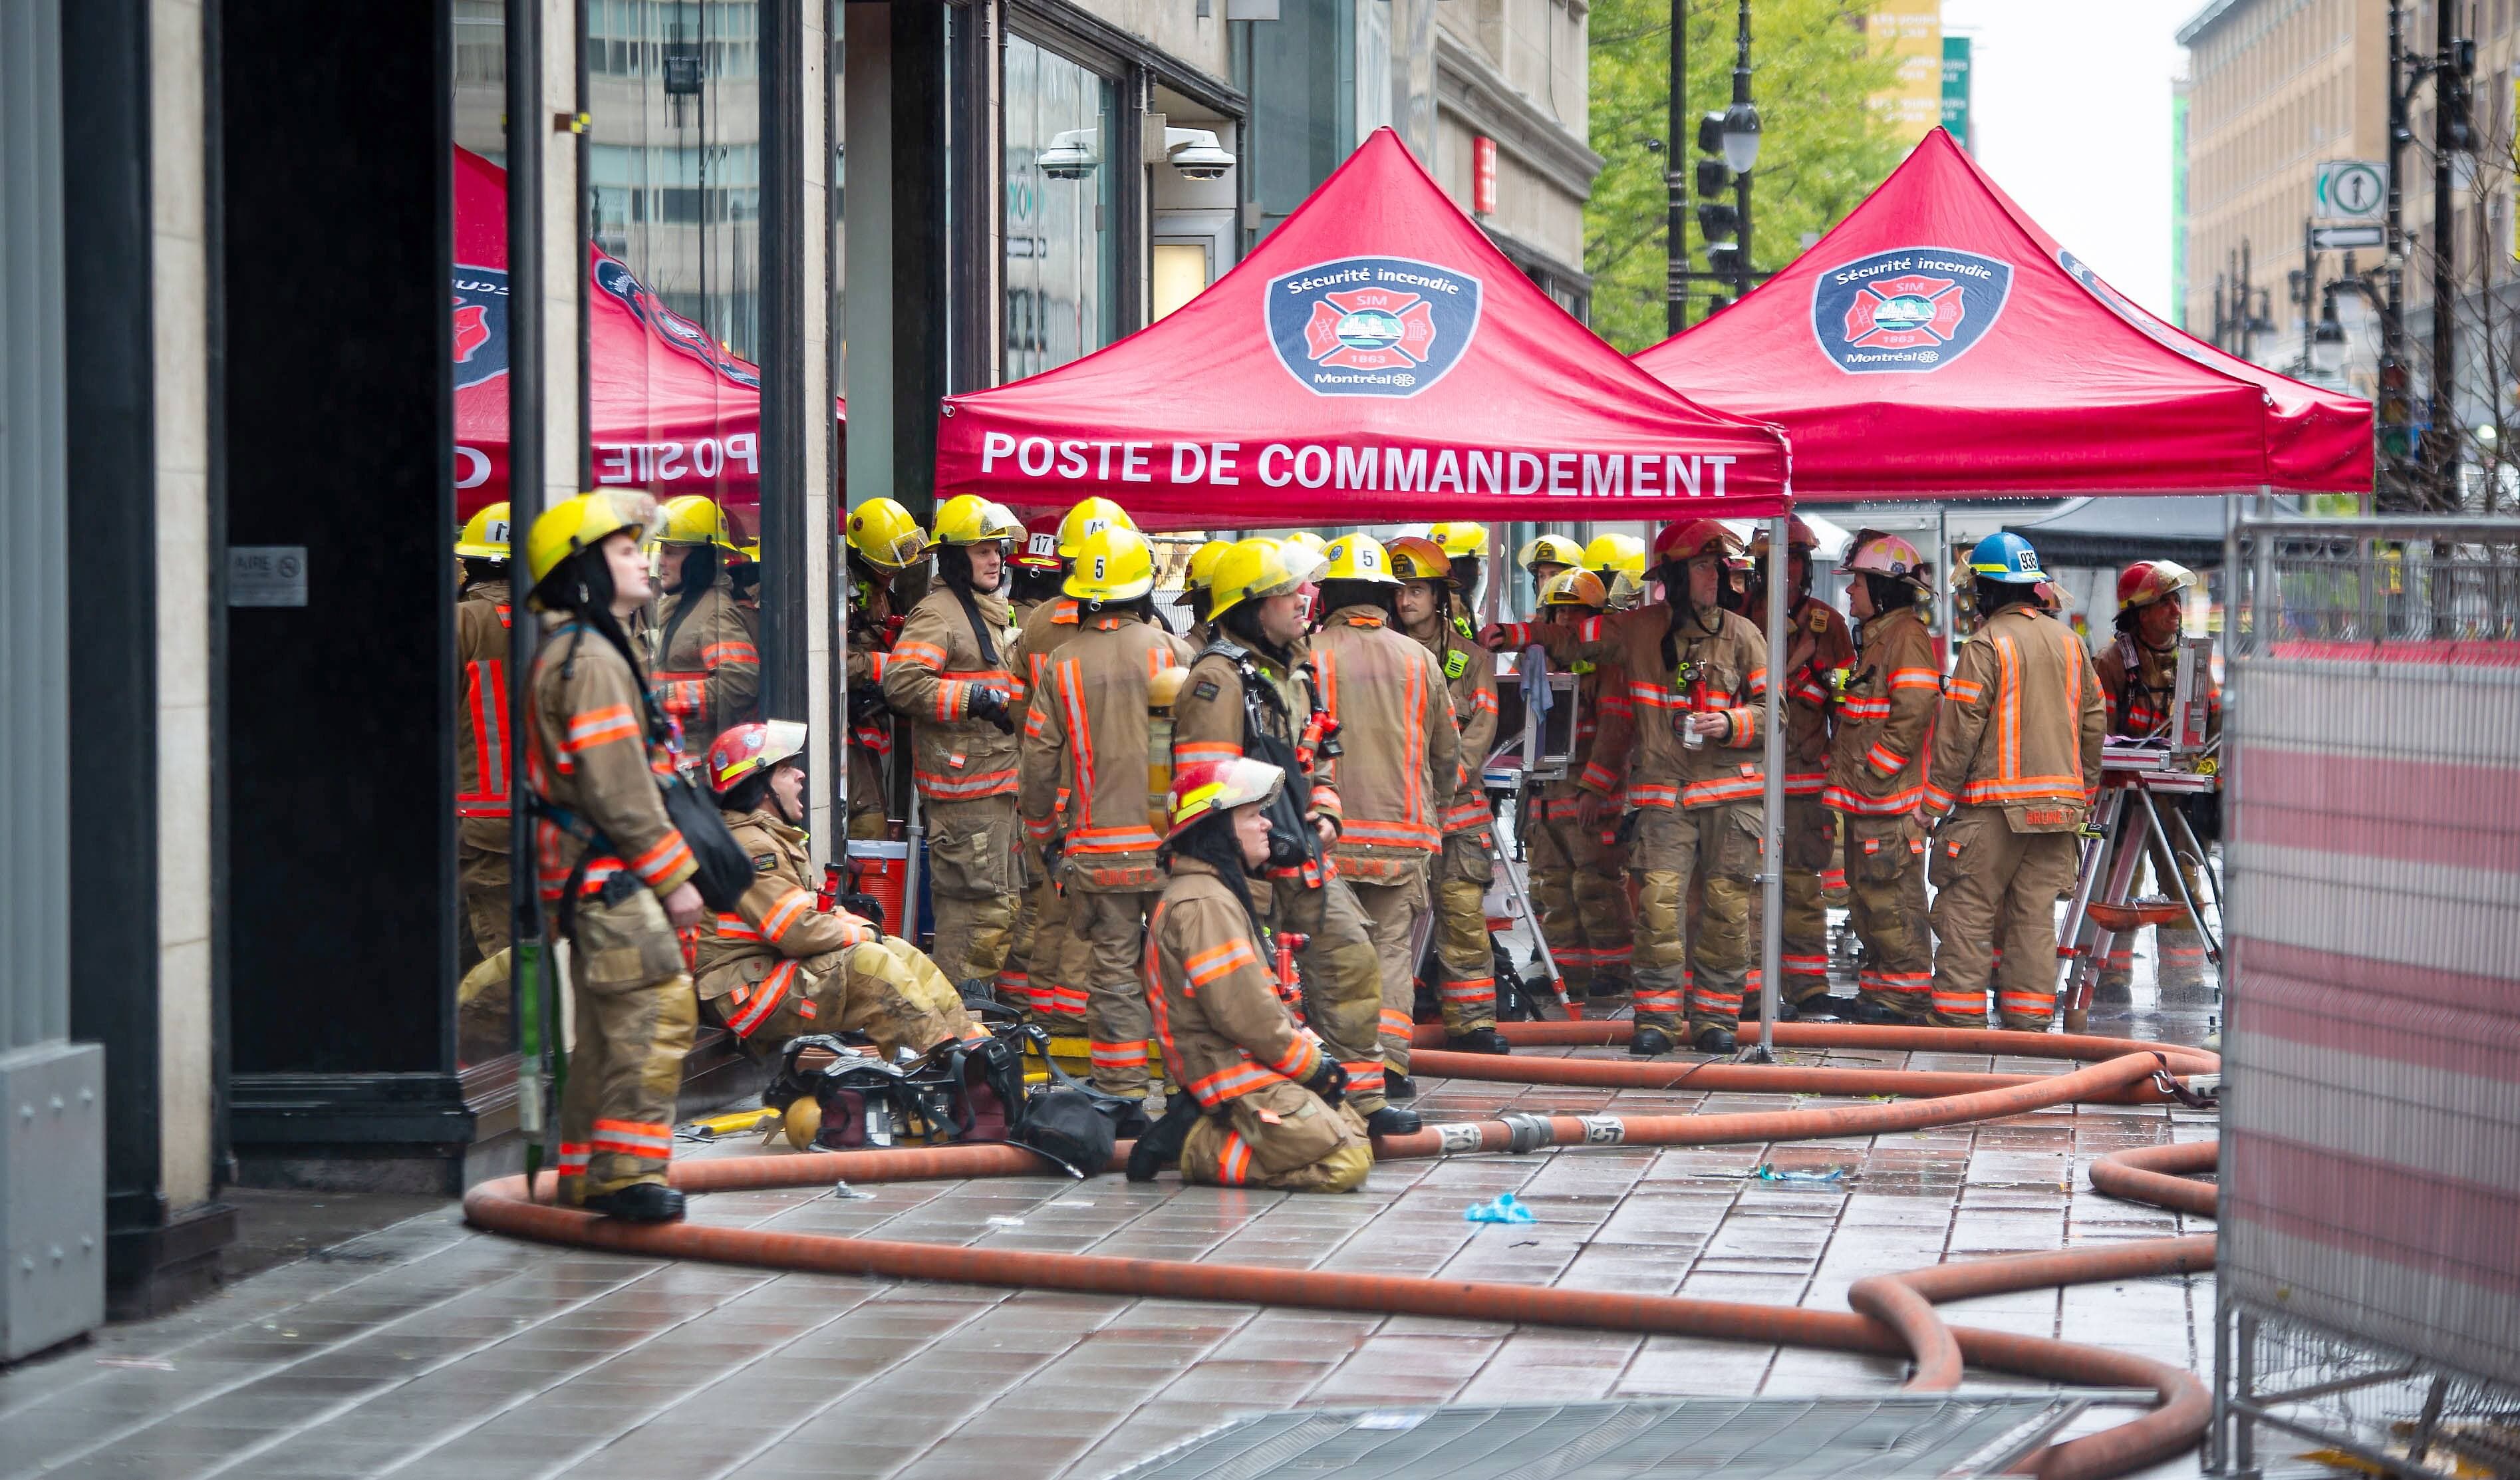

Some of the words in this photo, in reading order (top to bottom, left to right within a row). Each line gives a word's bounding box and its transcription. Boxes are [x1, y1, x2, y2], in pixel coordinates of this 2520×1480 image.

[1836, 257, 1911, 285] Sécurité
[1918, 257, 1993, 280] incendie
[1287, 267, 1371, 295] Sécurité
[1377, 267, 1460, 295] incendie
[1895, 282, 1925, 292] SIM
[1356, 295, 1387, 307] SIM
[1883, 335, 1915, 344] 1863
[1351, 355, 1386, 364] 1863
[1846, 352, 1917, 364] Montréal
[1314, 372, 1391, 385] Montréal
[982, 431, 1154, 482] POSTE
[1171, 442, 1240, 486] DE
[1258, 443, 1737, 498] COMMANDEMENT
[1035, 535, 1051, 553] 17
[1363, 550, 1374, 567] 5
[2020, 552, 2037, 570] 935
[1095, 559, 1104, 579] 5
